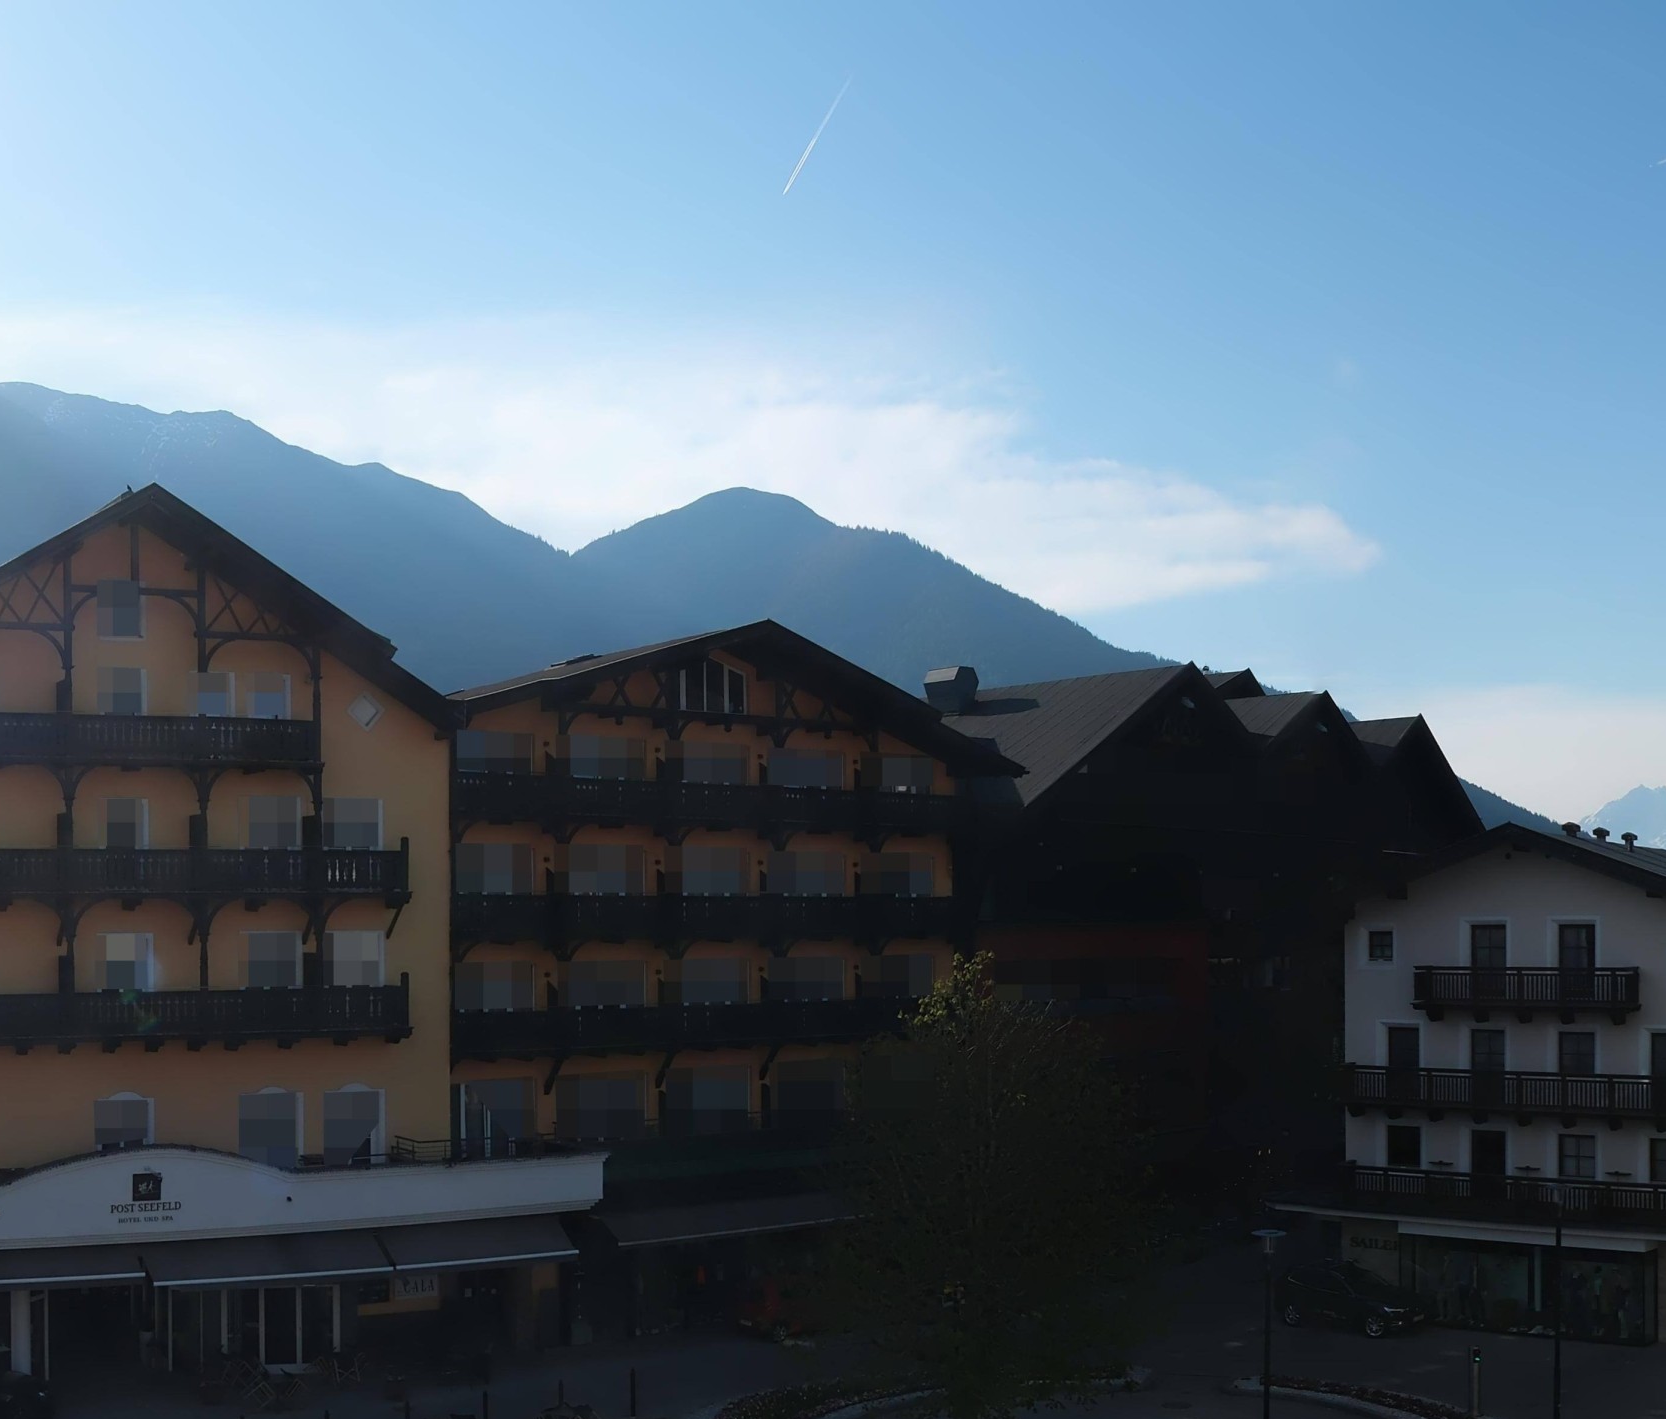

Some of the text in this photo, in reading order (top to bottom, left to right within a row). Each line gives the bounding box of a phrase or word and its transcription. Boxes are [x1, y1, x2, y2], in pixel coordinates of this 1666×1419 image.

[110, 1201, 182, 1214] POST SEEFELD
[118, 1216, 141, 1224] HOTEL
